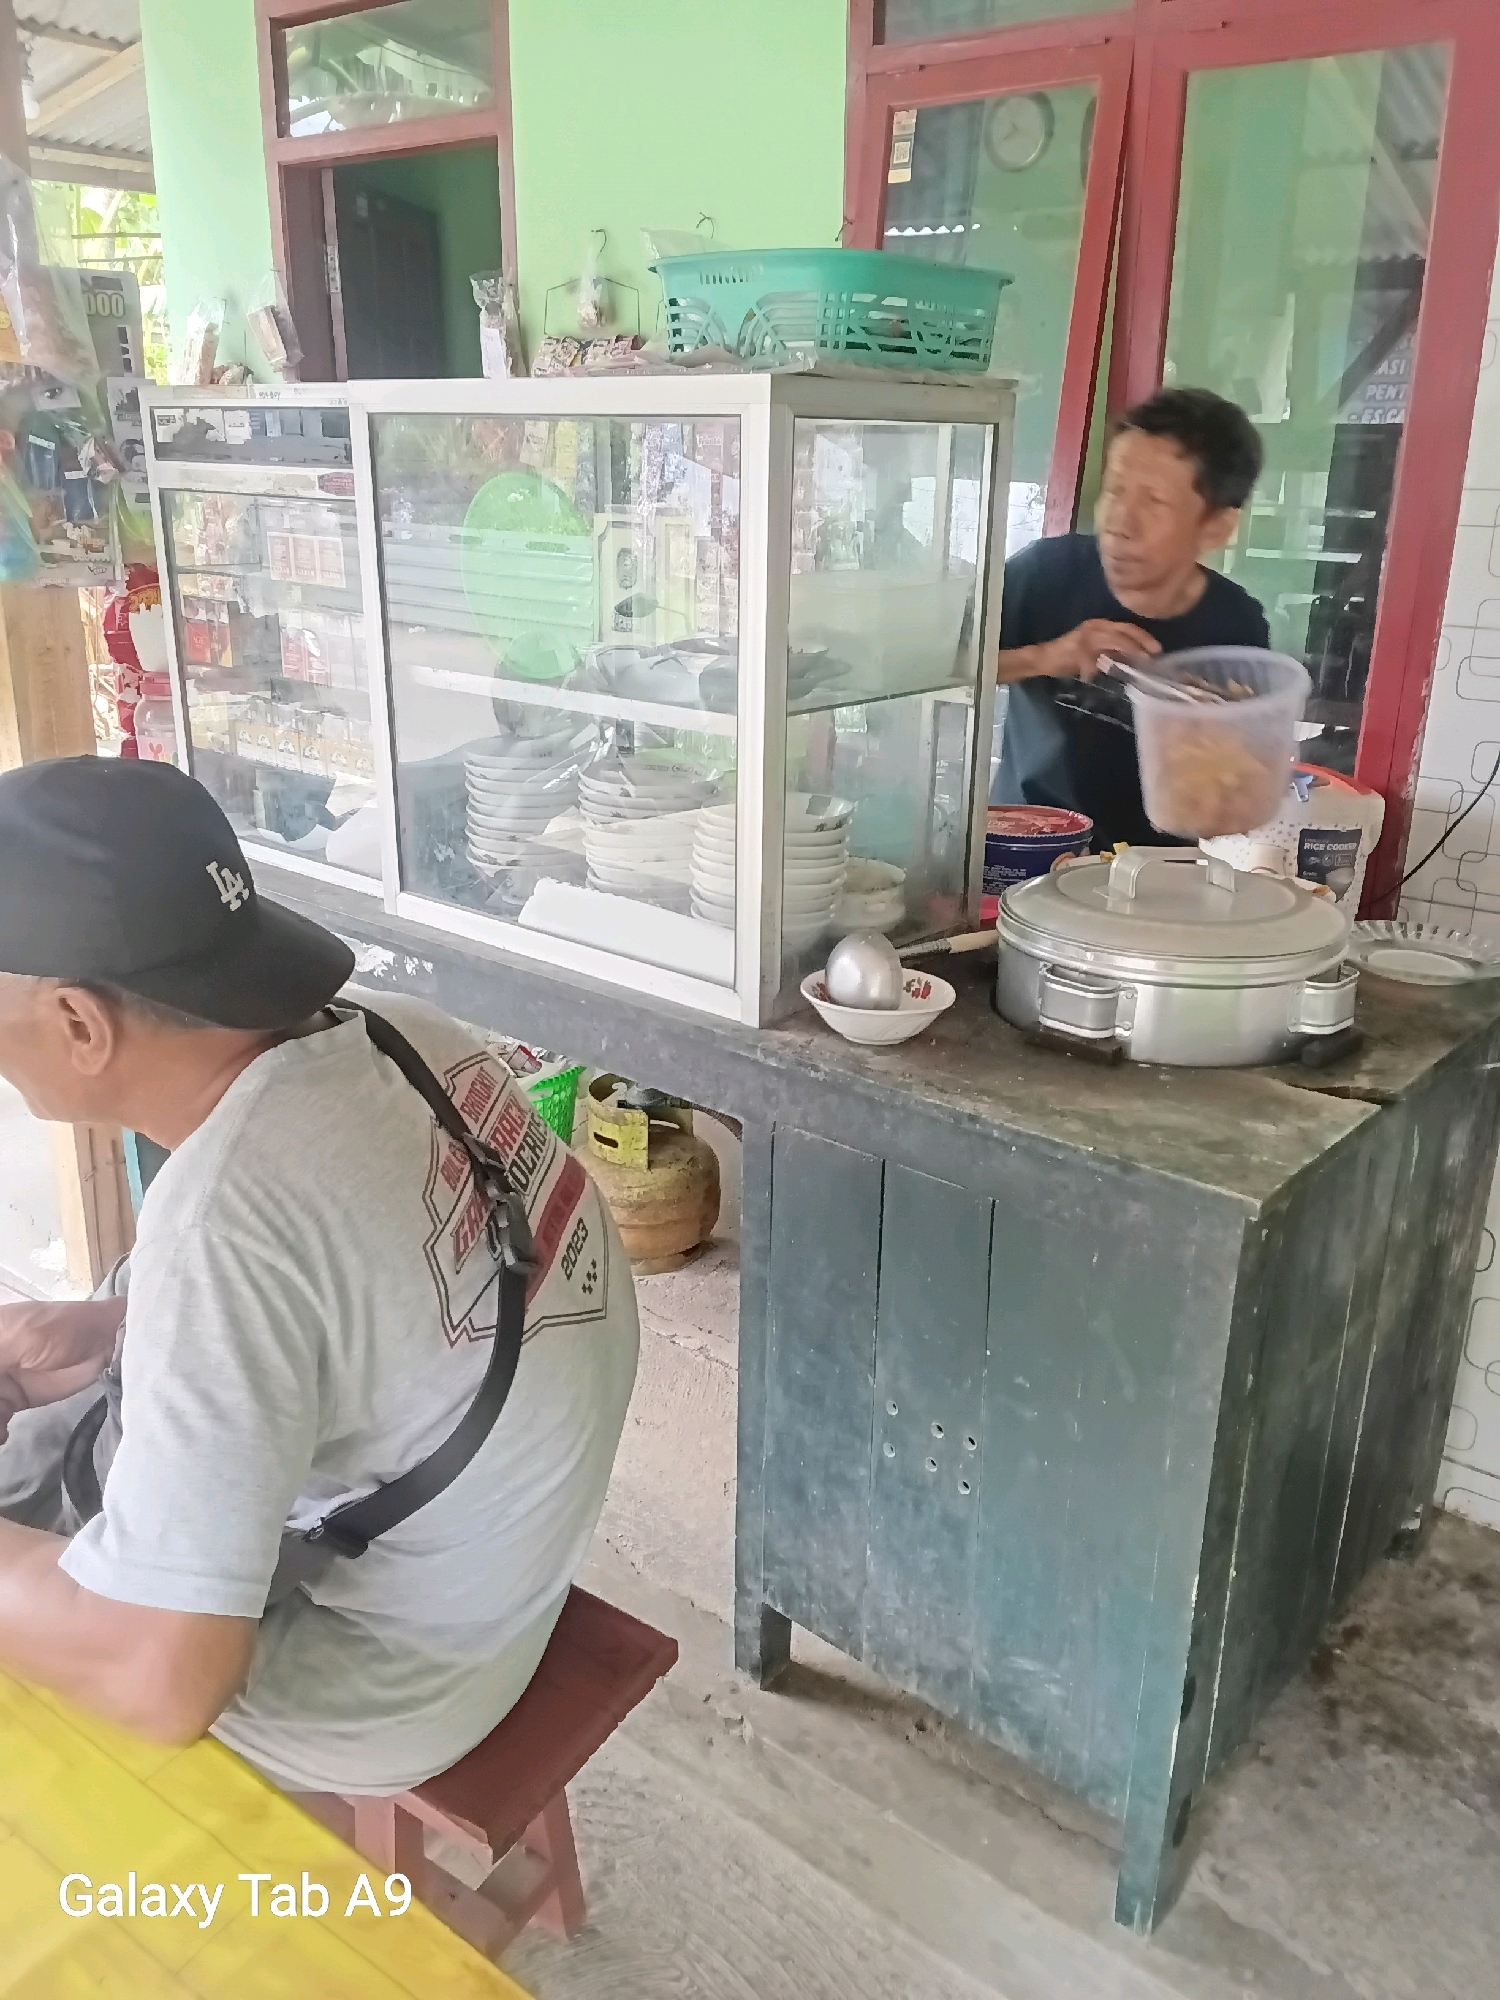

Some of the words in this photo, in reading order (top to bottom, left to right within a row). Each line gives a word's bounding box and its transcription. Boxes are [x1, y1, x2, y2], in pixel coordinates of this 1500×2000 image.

[1303, 842, 1326, 851] RICE
[1326, 842, 1358, 851] COOKER
[205, 860, 250, 911] LA
[561, 1217, 589, 1281] 2023
